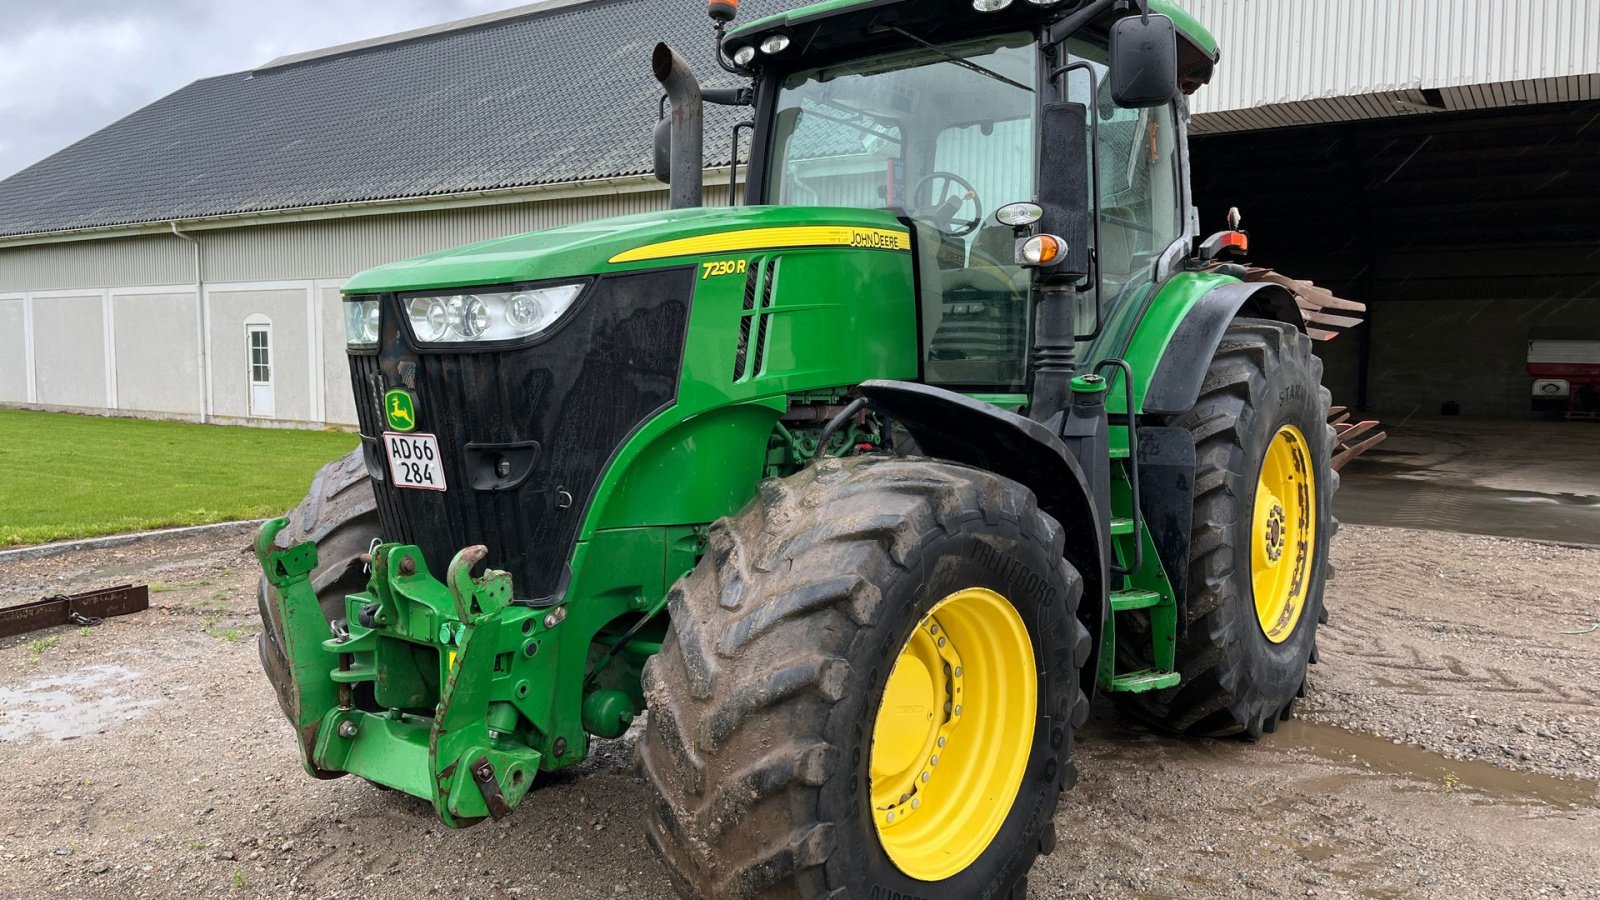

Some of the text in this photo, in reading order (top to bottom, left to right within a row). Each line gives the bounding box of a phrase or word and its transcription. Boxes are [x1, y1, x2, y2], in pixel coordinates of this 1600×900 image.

[850, 230, 873, 247] JOHN
[873, 231, 899, 249] DEERE
[702, 259, 746, 280] 7230 R
[391, 438, 434, 461] AD66
[401, 462, 433, 485] 284
[970, 539, 1057, 608] TRELLEBORG
